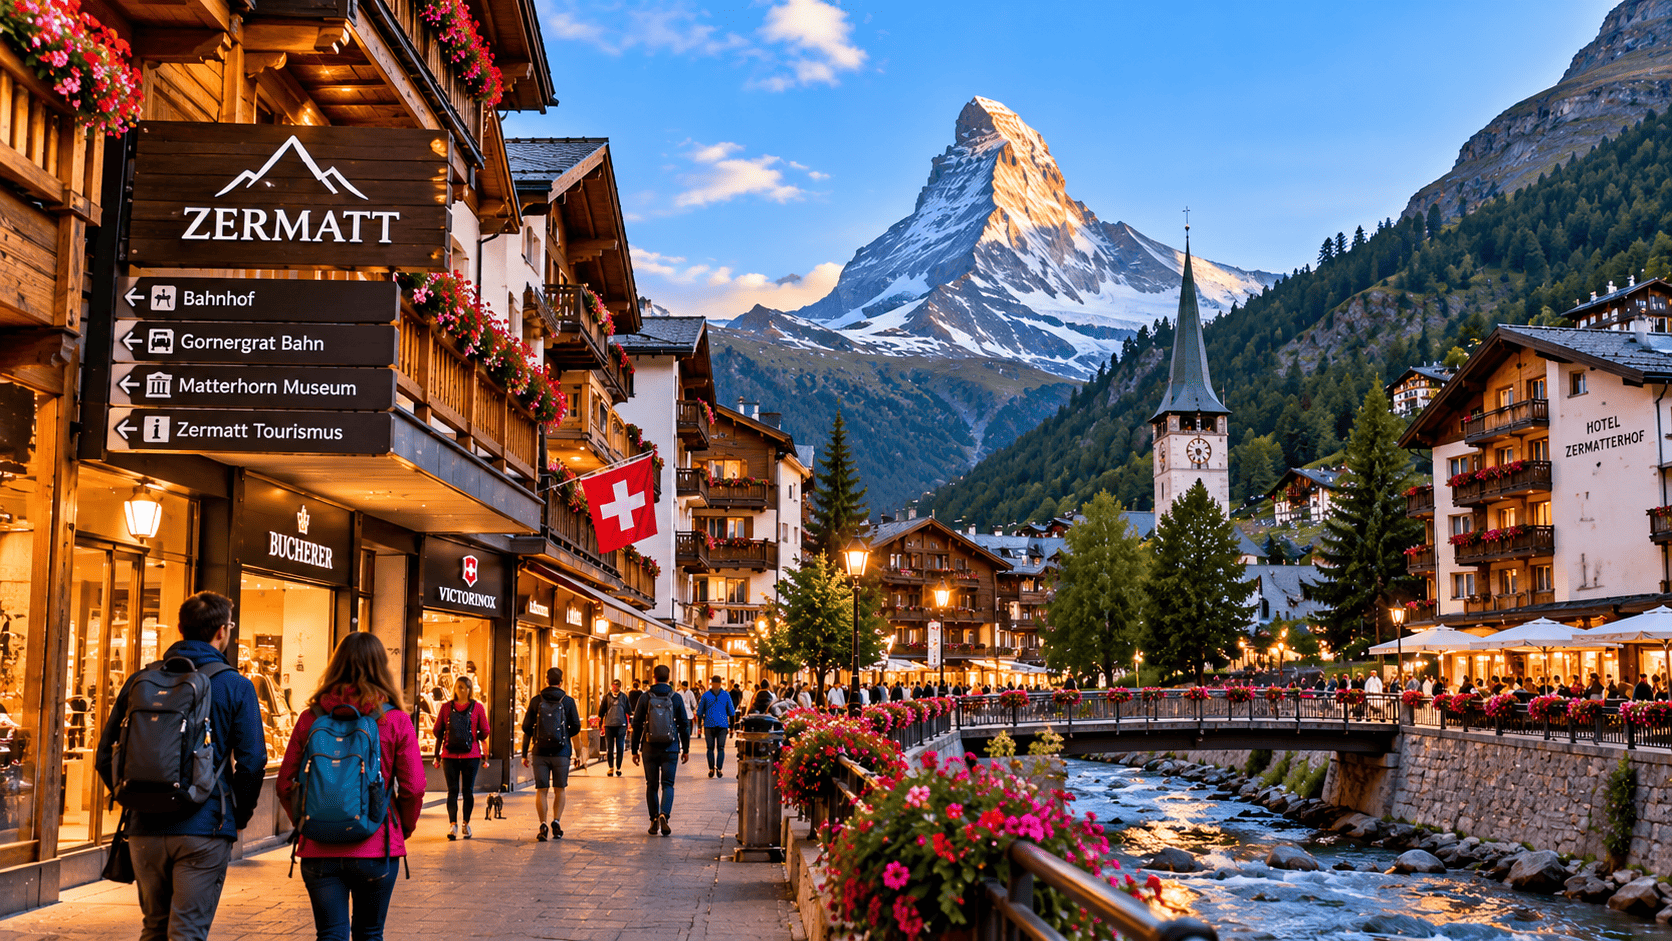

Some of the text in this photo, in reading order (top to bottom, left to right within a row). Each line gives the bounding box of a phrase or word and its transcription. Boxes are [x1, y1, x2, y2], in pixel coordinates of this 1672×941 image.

[181, 206, 400, 244] ZERMATT
[183, 290, 256, 307] Bahnhof
[180, 333, 325, 354] Gornergrat Bahn
[178, 377, 357, 396] Matterhorn Museum
[176, 421, 343, 440] Zermatt Tourismus
[1586, 415, 1621, 435] HOTEL
[1565, 429, 1645, 458] ZERMATTERHOF
[268, 530, 333, 570] BUCHERER
[438, 586, 497, 610] VICTORINOX
